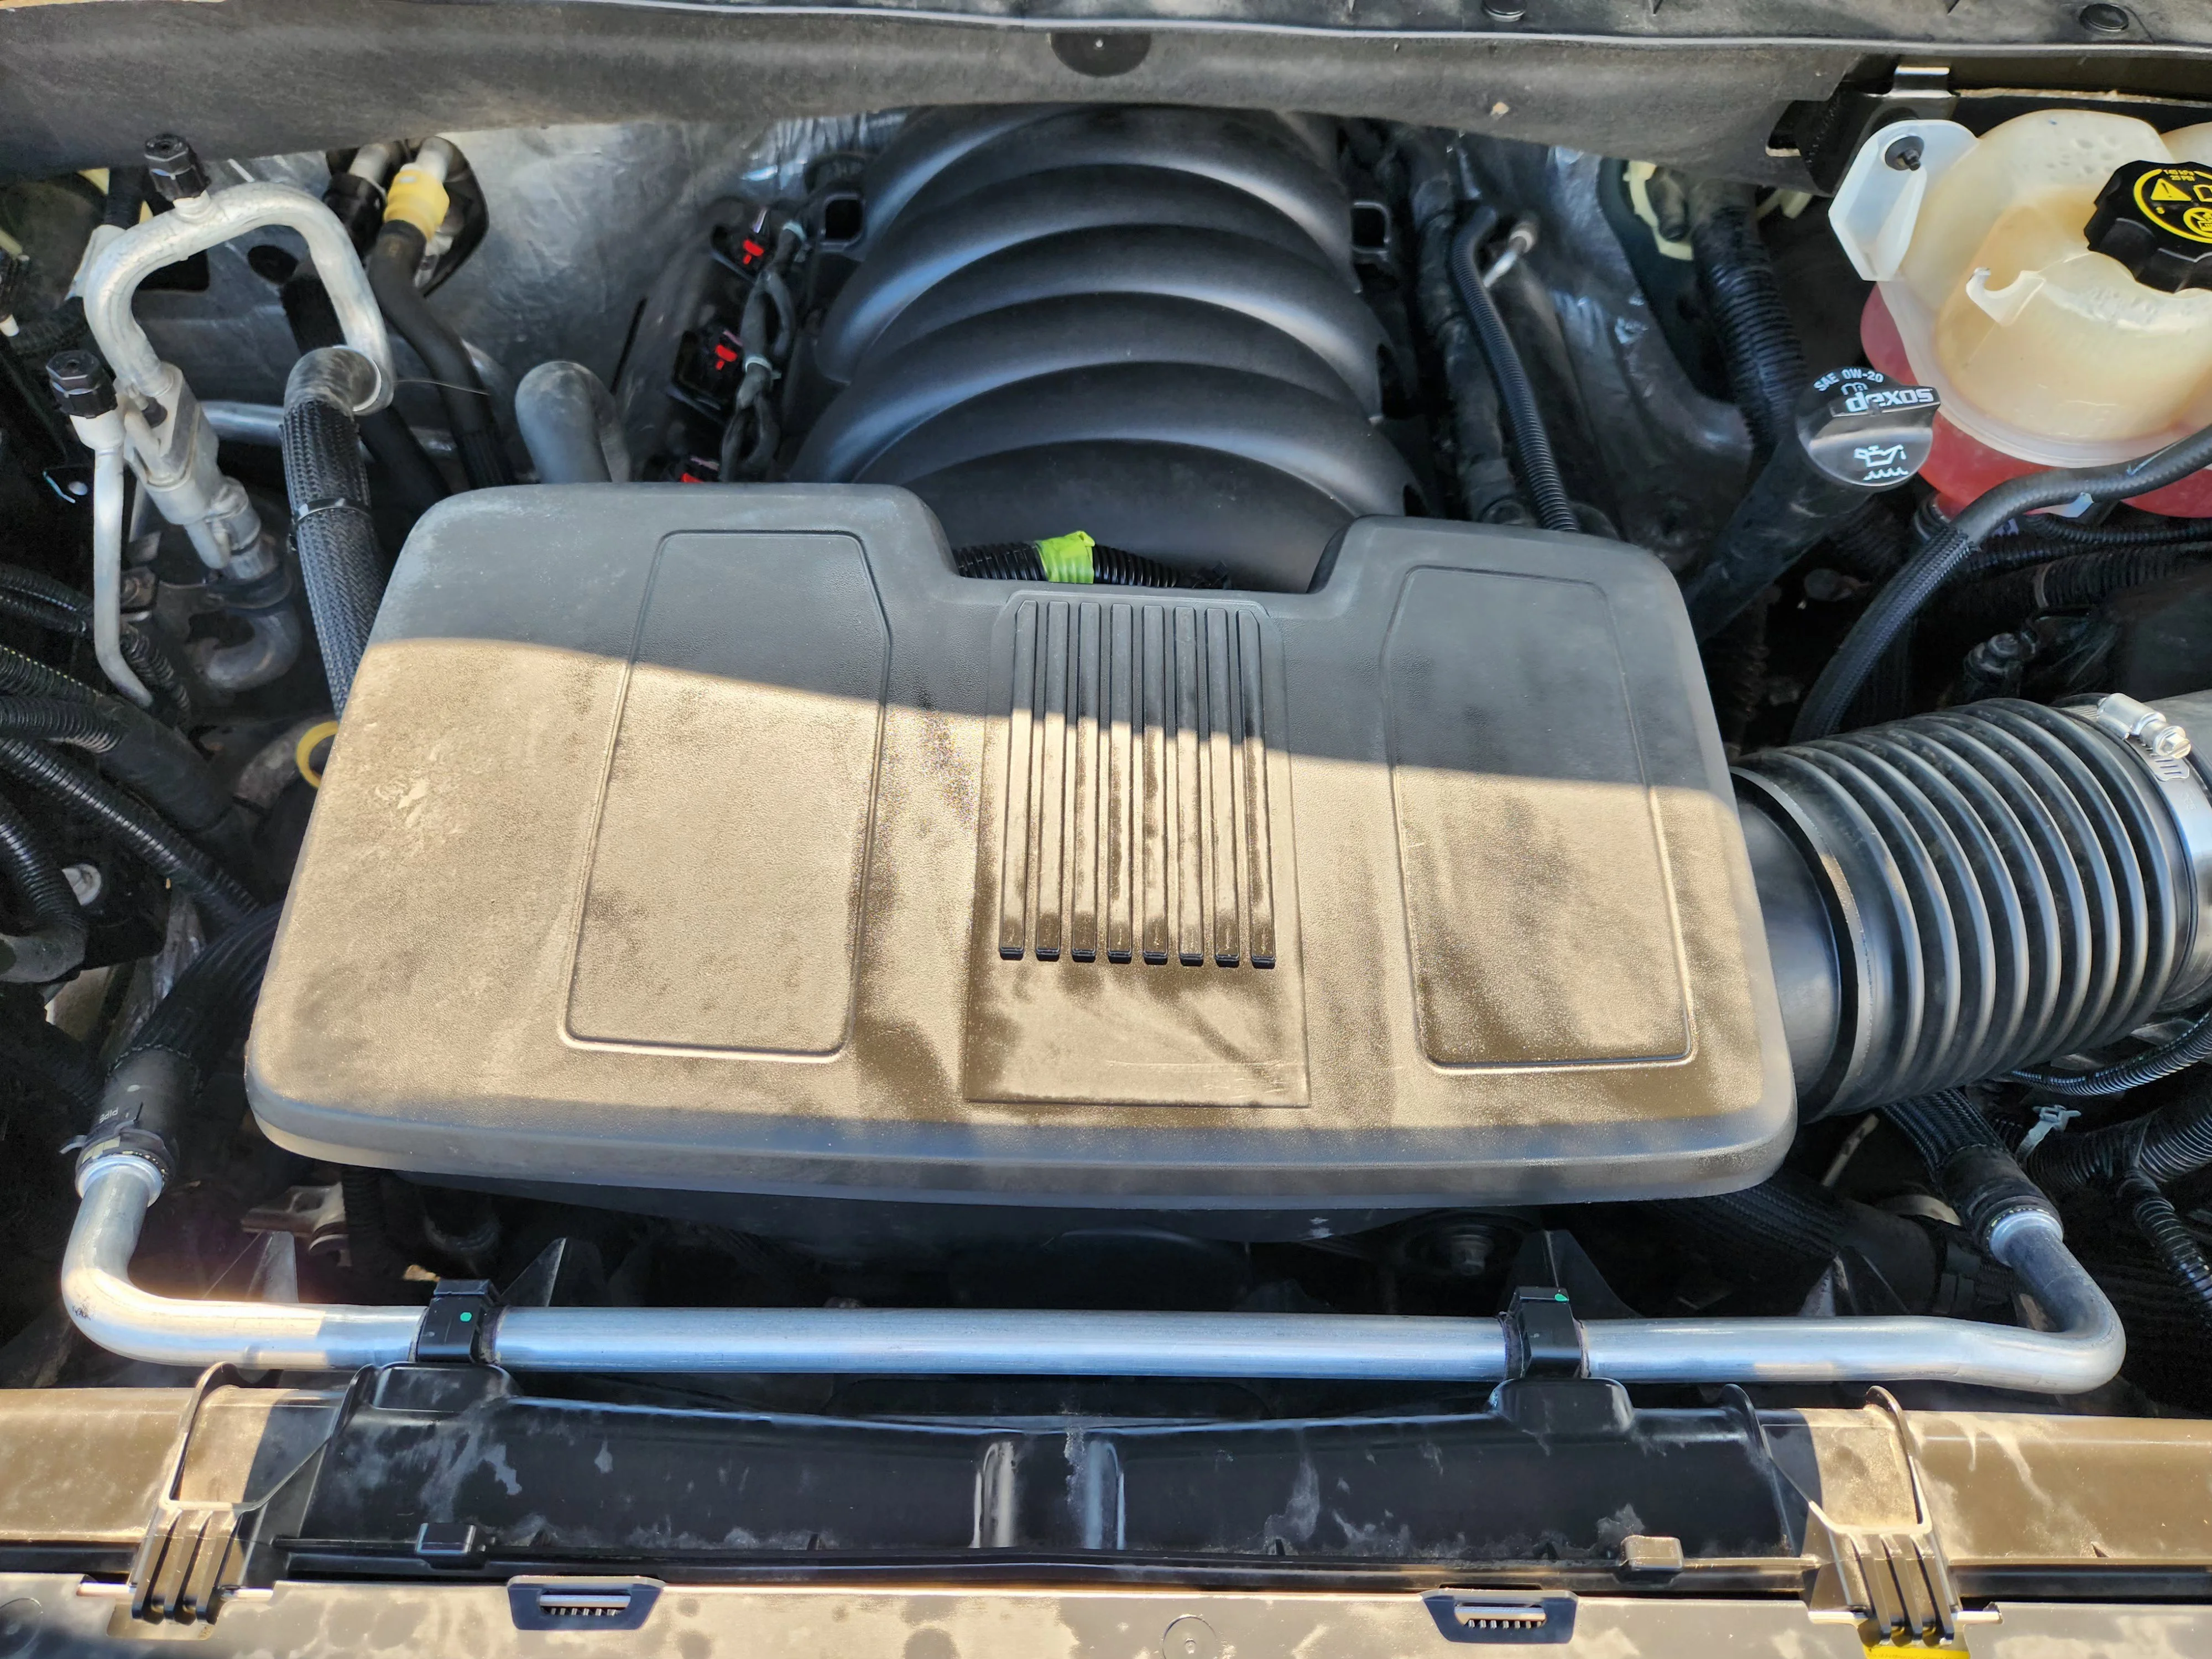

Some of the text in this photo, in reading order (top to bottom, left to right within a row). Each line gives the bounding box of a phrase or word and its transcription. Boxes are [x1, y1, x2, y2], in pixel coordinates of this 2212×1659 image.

[1813, 367, 1884, 392] SAE 0W-20
[1844, 388, 1934, 413] dexos
[99, 1107, 119, 1124] PIPE
